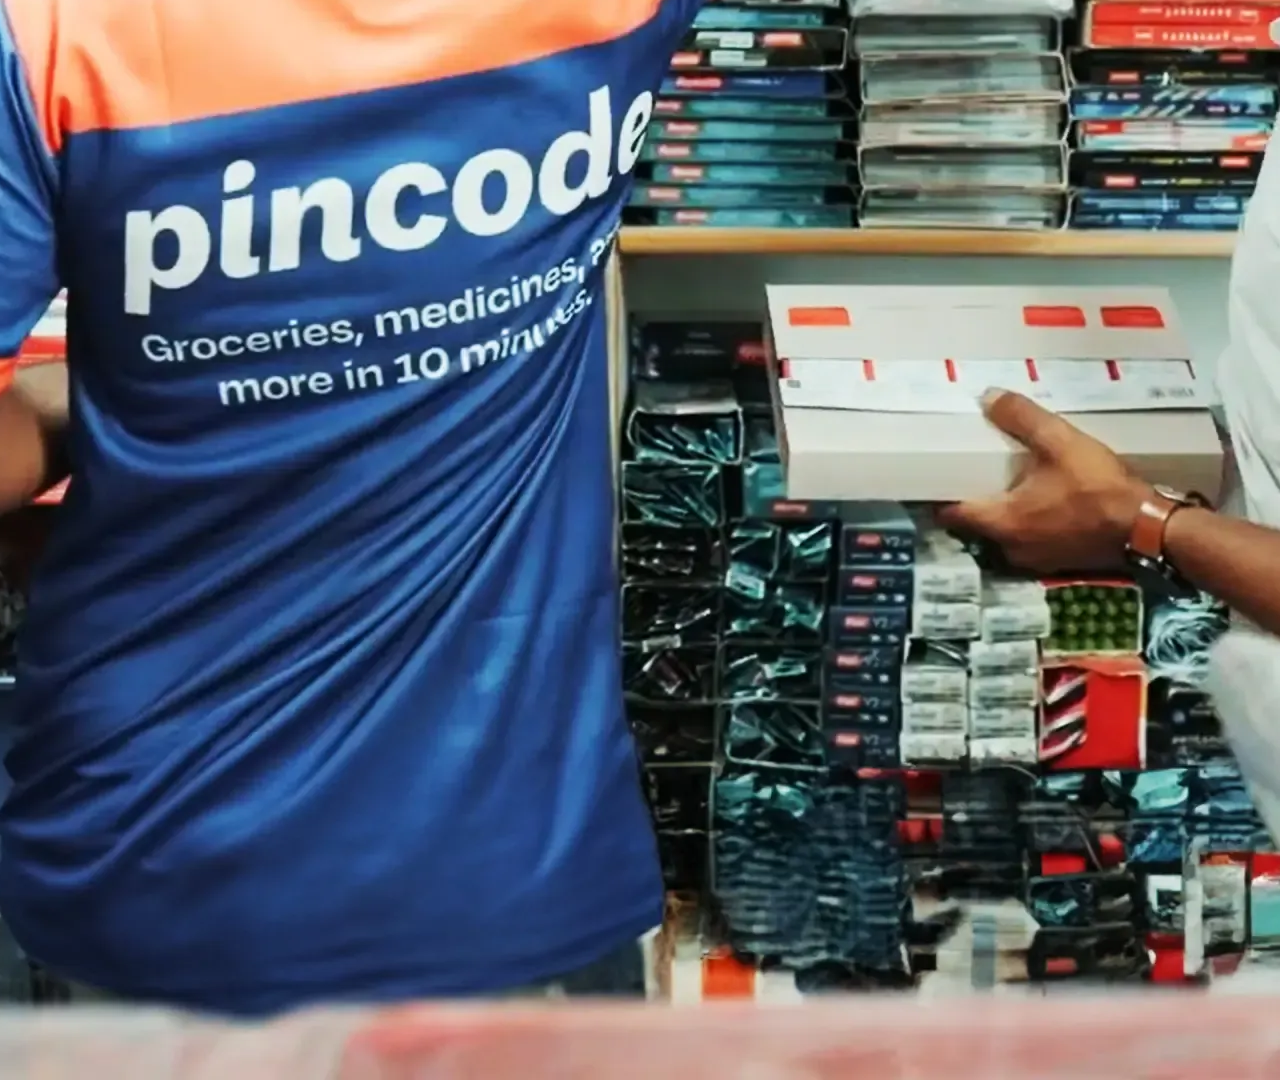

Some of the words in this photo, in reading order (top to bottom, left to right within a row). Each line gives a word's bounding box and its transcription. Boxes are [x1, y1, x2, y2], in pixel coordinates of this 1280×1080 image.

[124, 84, 654, 315] pincode
[141, 319, 365, 363] Groceries,
[375, 258, 585, 339] medicines,
[219, 370, 334, 406] more
[344, 360, 384, 391] in
[394, 347, 450, 382] 10
